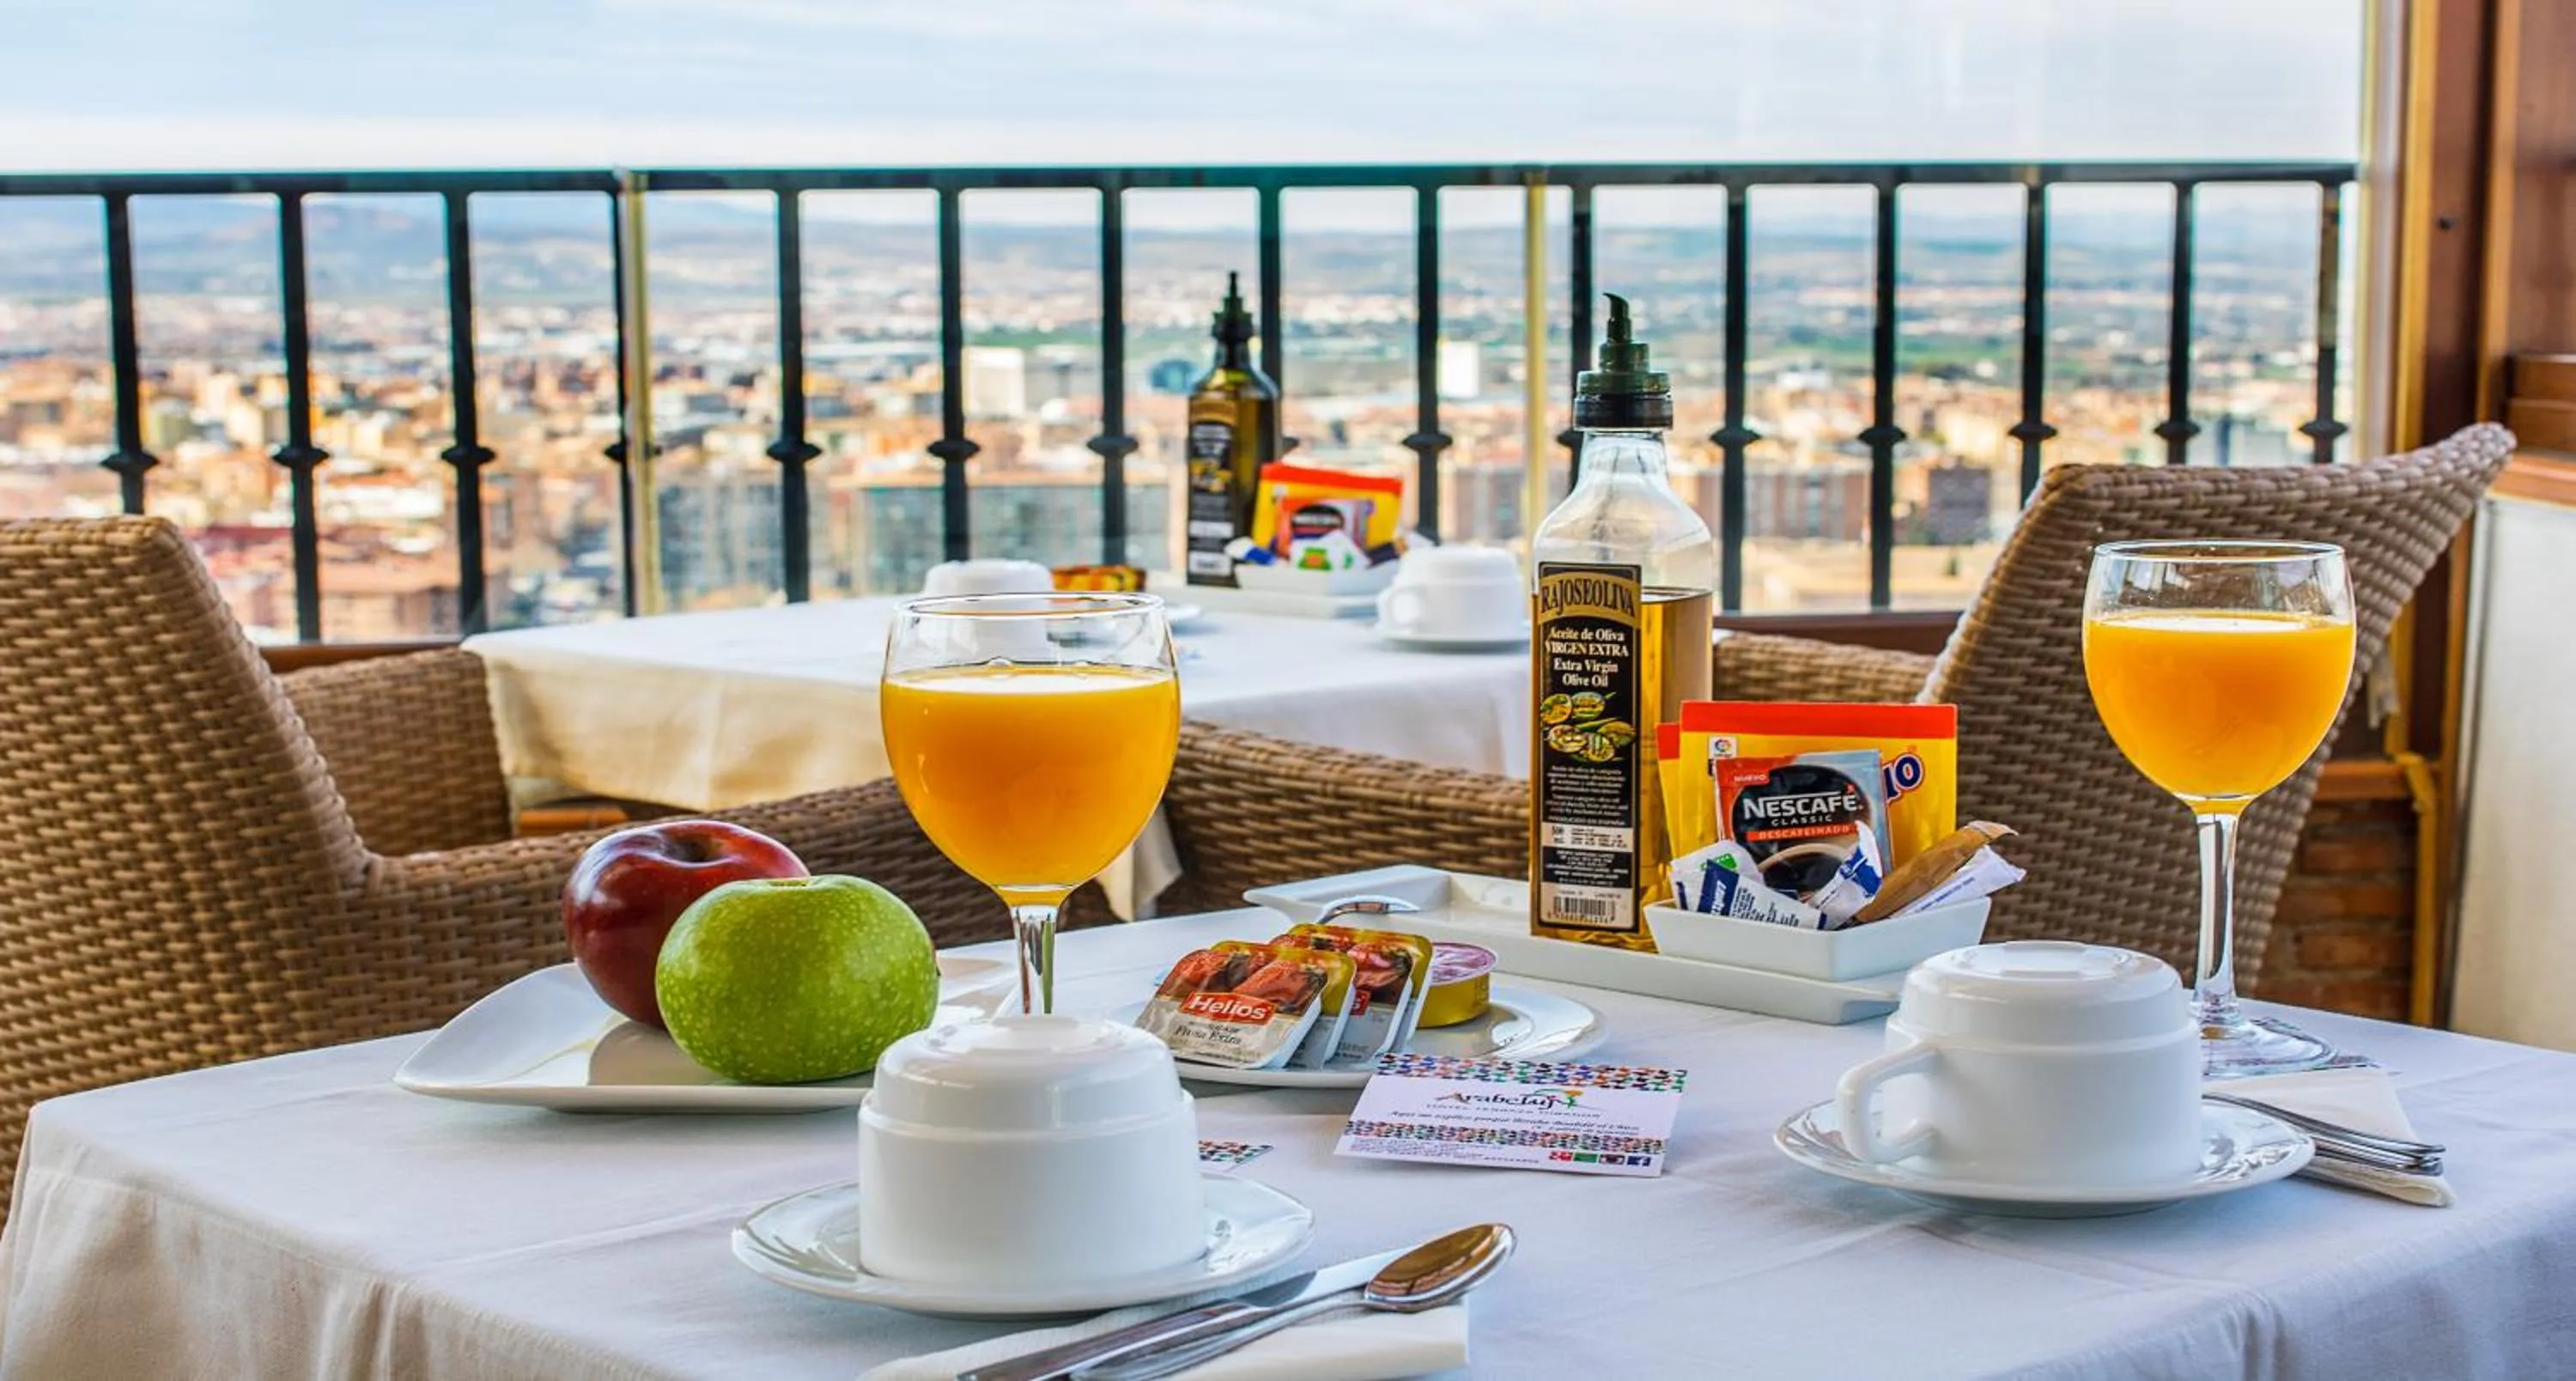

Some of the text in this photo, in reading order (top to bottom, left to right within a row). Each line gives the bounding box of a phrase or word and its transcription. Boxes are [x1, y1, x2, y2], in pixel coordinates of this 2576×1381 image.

[1540, 578, 1635, 617] RAJOSEOLIVA
[1549, 627, 1625, 642] Aceite de Oliva
[1545, 641, 1629, 657] VIRGEN EXTRA
[1553, 658, 1619, 674] Extra Virgin
[1562, 673, 1608, 688] Olive Oil
[1771, 813, 1834, 827] CLASSIC
[1758, 823, 1850, 840] DESCAFEINADO
[1188, 994, 1268, 1020] Helios
